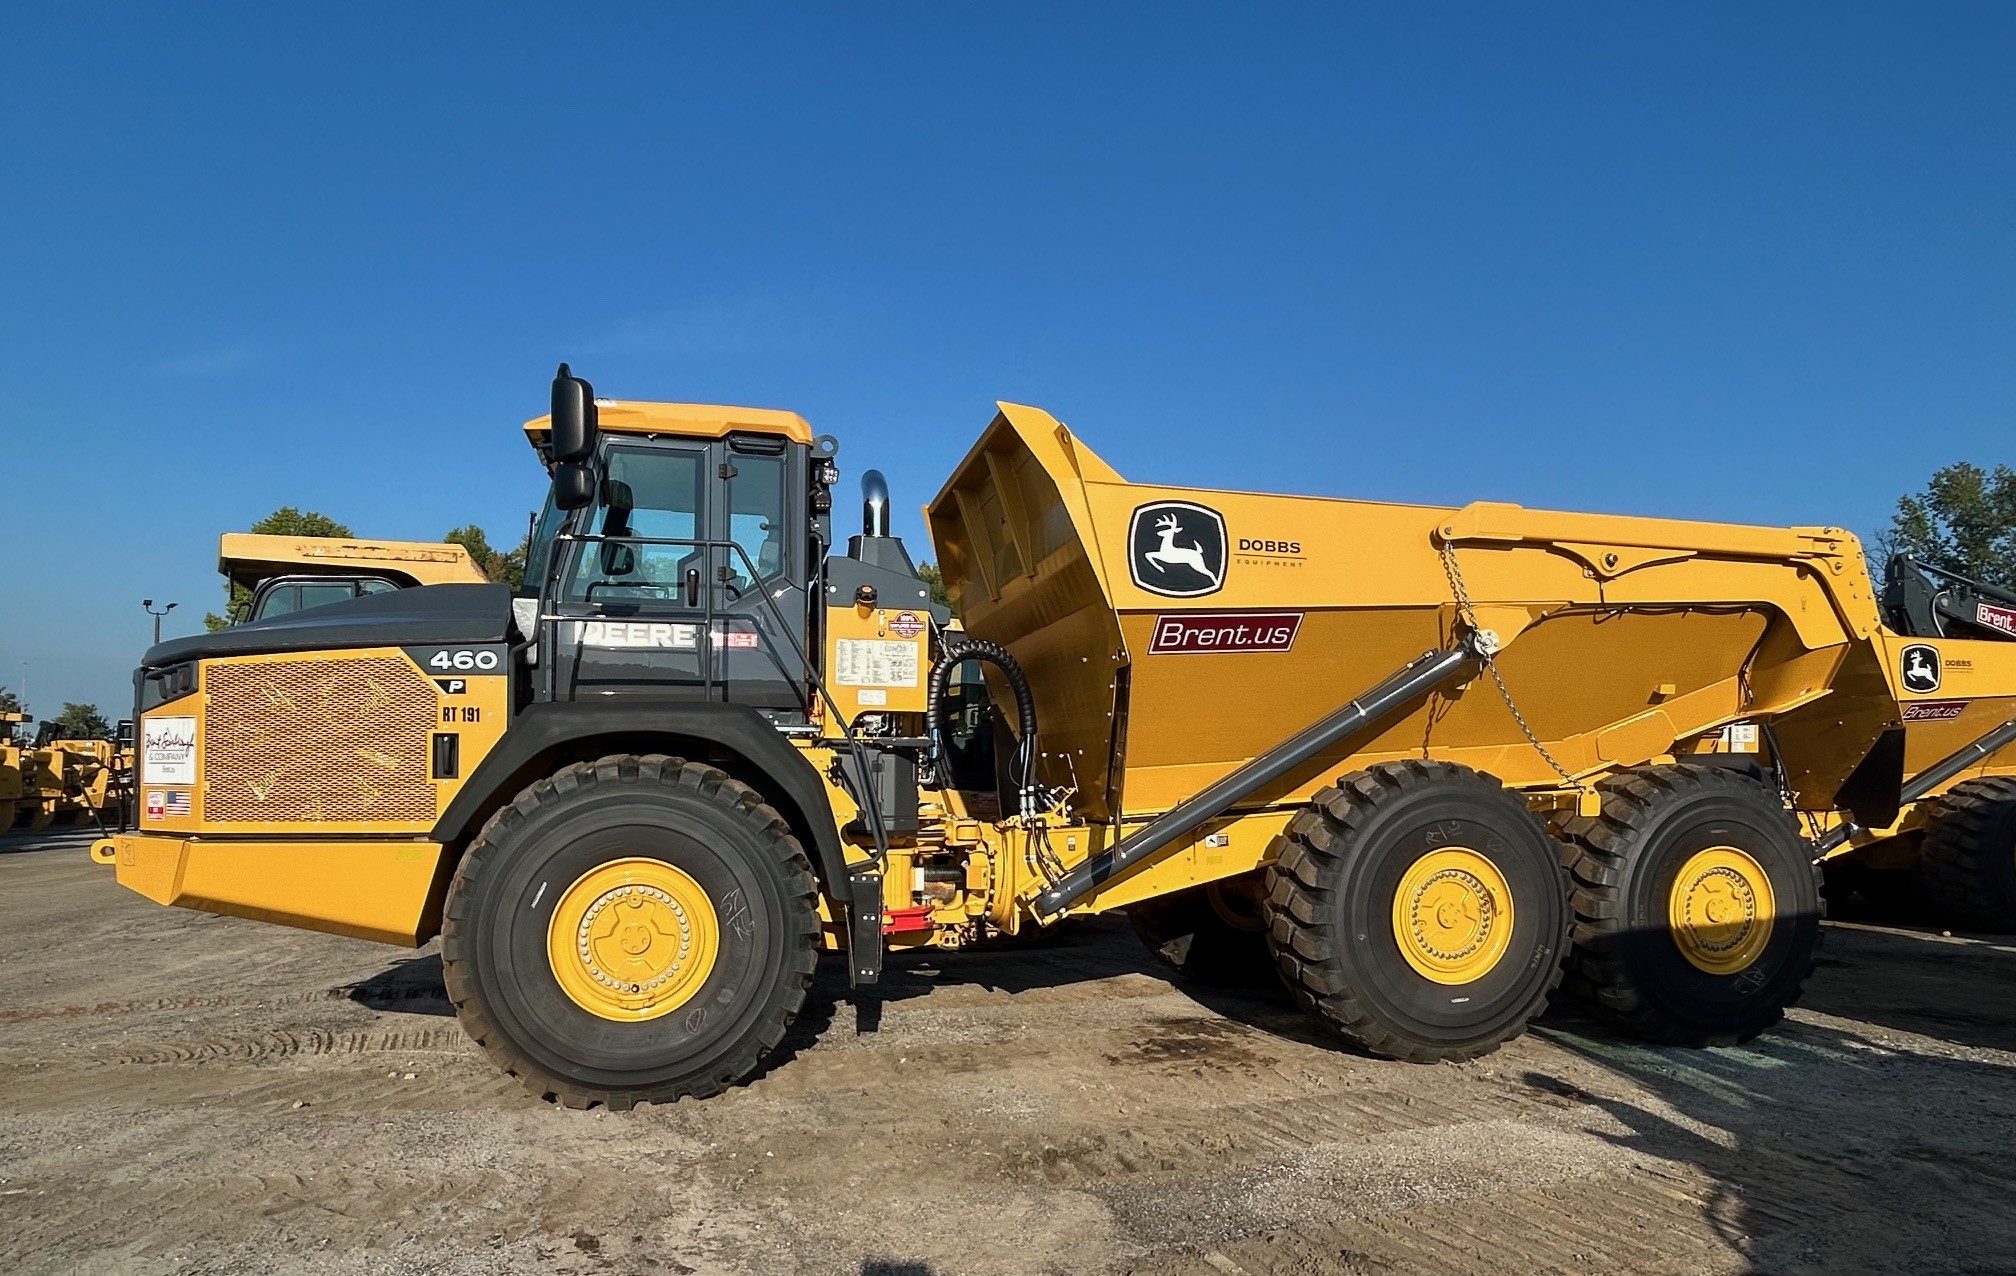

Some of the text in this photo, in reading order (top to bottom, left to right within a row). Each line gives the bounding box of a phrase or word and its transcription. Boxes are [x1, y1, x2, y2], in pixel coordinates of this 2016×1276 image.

[1239, 539, 1301, 554] DOBBS
[1236, 558, 1303, 568] EQUIPMENT
[1980, 606, 2016, 632] Brent.
[574, 621, 698, 648] DEERE
[1158, 622, 1291, 648] Brent.us
[429, 650, 499, 670] 460
[448, 680, 464, 693] P
[442, 706, 480, 722] RT 191
[154, 752, 184, 761] COMPANY
